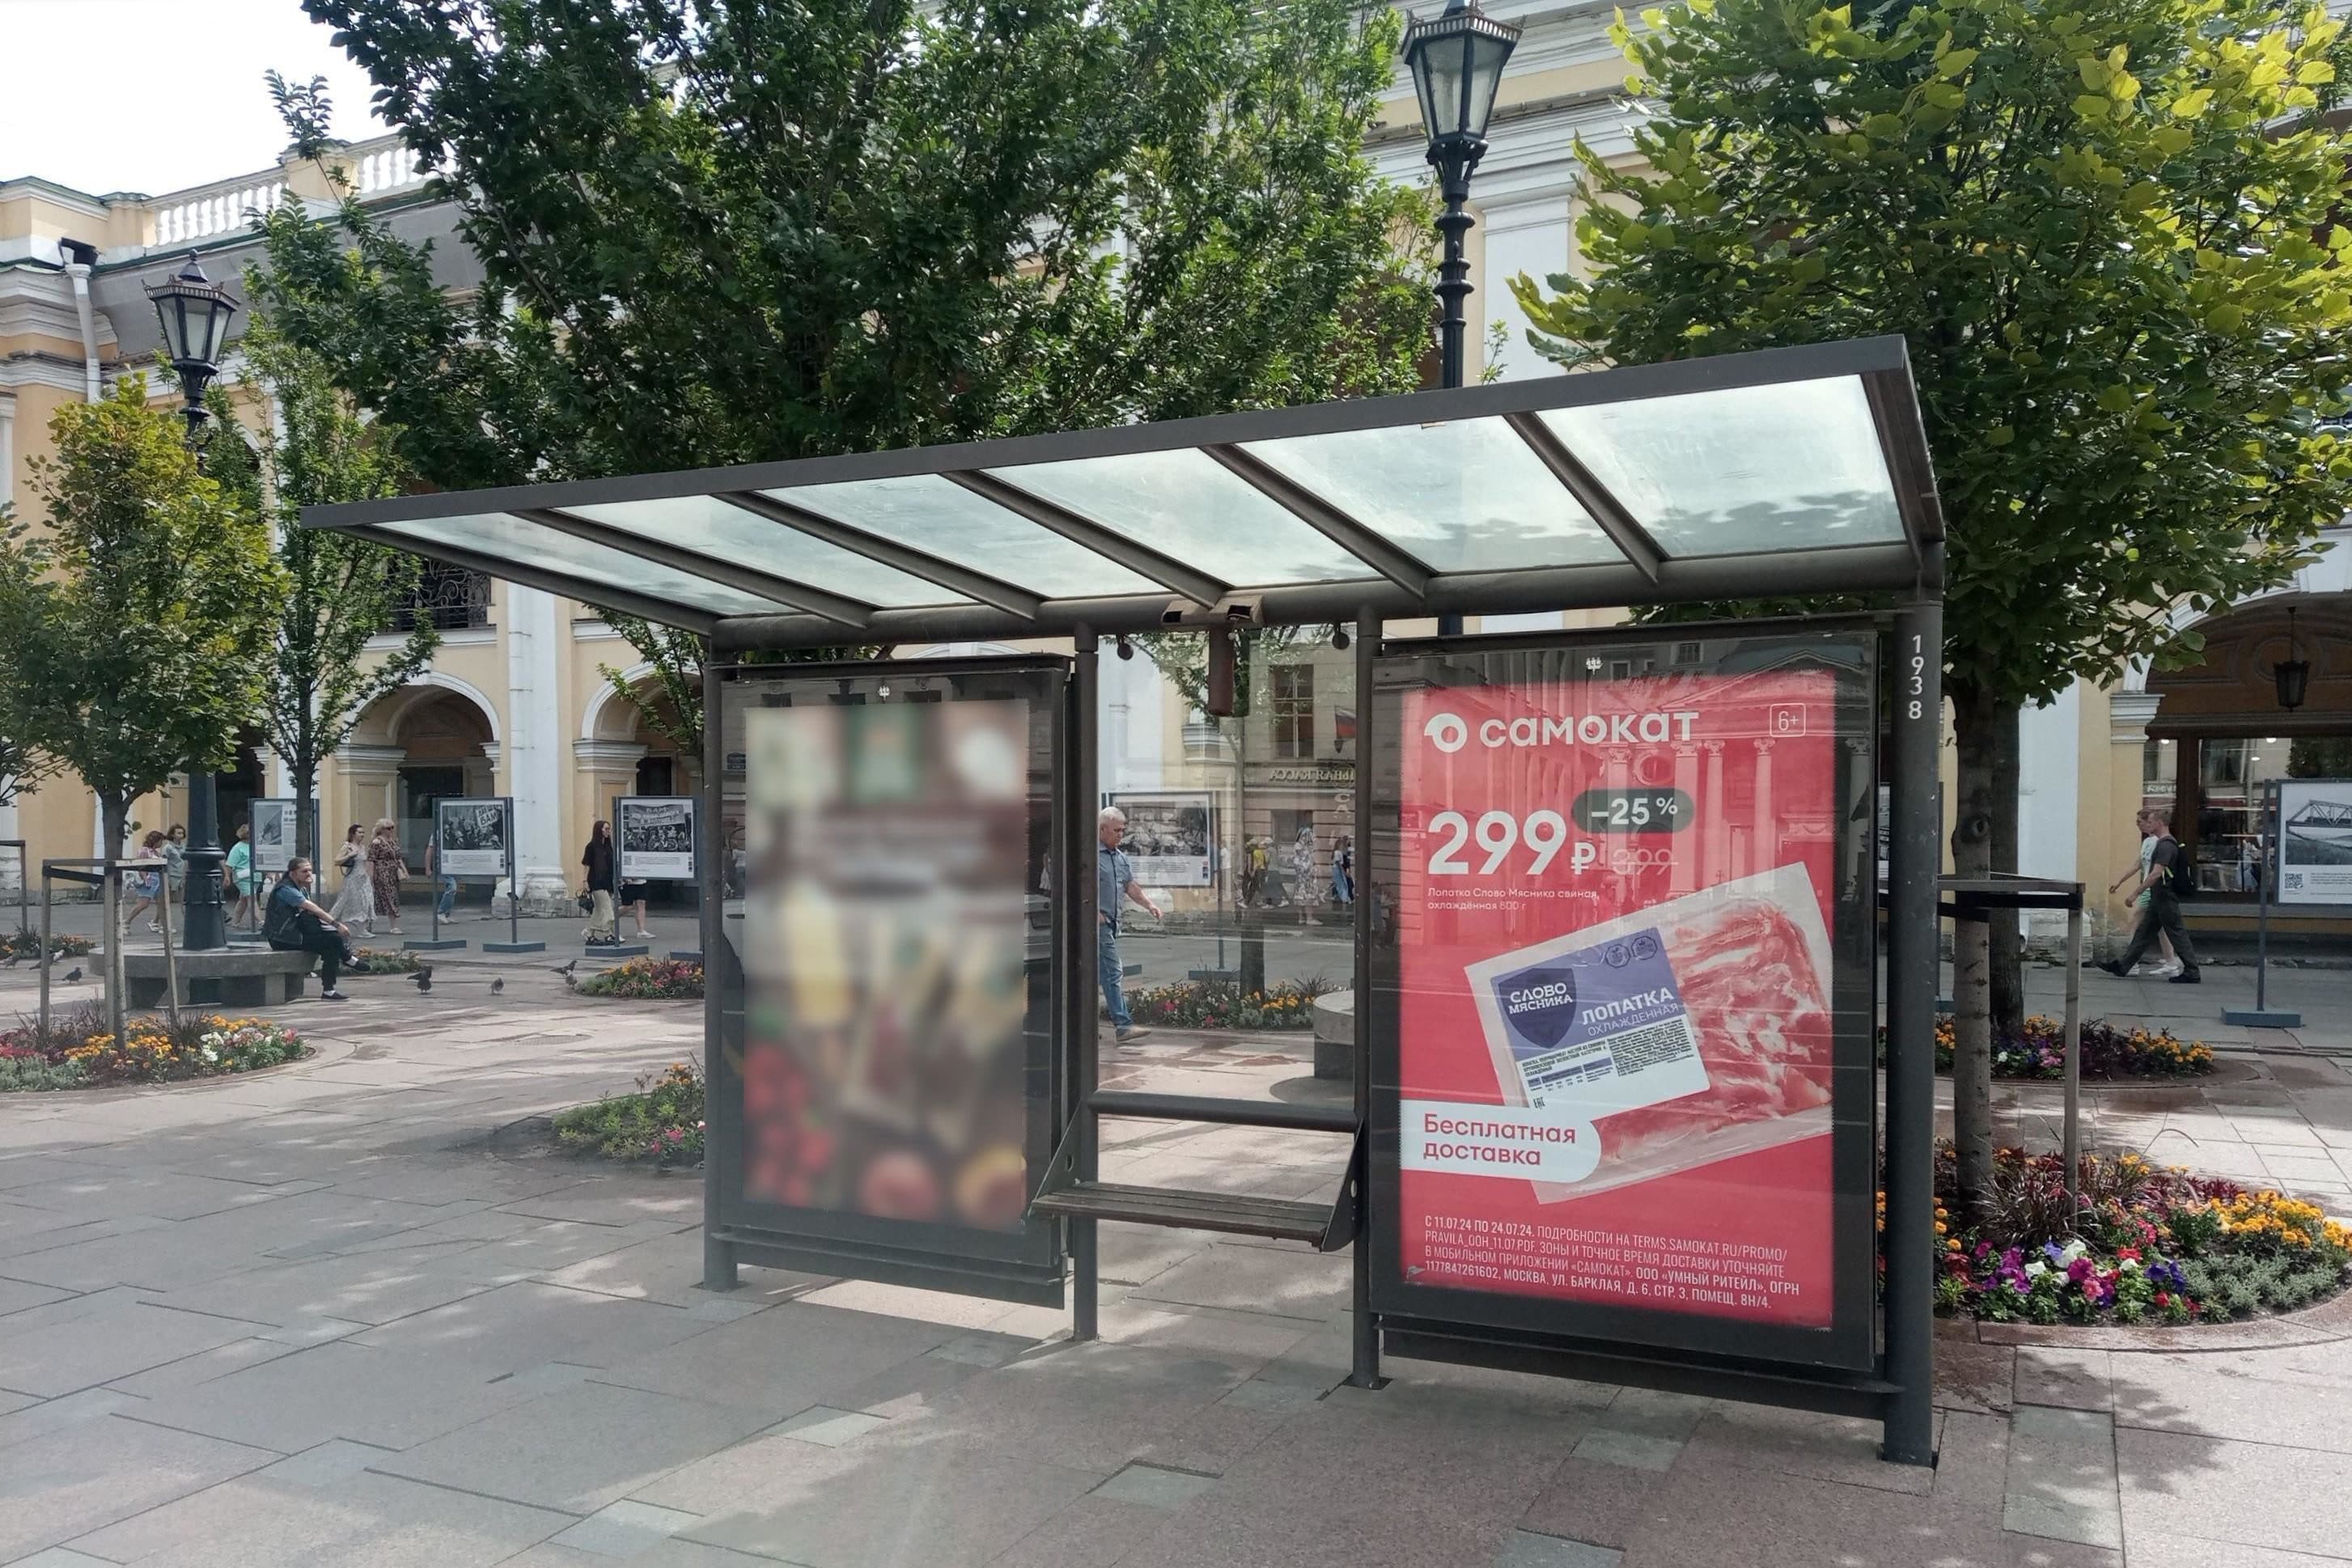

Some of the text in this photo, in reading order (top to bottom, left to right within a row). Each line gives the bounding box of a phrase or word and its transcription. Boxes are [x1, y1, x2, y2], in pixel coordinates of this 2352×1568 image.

[1909, 634, 1924, 719] 1938
[1778, 710, 1799, 731] 6+
[1428, 888, 1600, 900] Лопатка Слово Мясника свиная,
[1509, 994, 1573, 1015] МЯСНИКА
[1511, 982, 1567, 1004] СЛОВО
[1582, 987, 1674, 1025] ЛОПАТКА
[1588, 1003, 1679, 1036] ОХЛАЖДЕННАЯ
[1425, 1113, 1575, 1144] Бесплатная
[1423, 1142, 1540, 1166] доставка
[1426, 1215, 1788, 1261] С 11.07.24 ПО 24.07.24. ПОДРОБНОСТИ НА TERMS.SAMOKAT.RU/PROMO/
[1426, 1245, 1432, 1257] В
[1434, 1246, 1497, 1265] МОБИЛЬНОМ
[1499, 1252, 1569, 1271] ПРИЛОЖЕНИИ
[1636, 1267, 1659, 1280] ООО
[1662, 1270, 1710, 1286] «УМНЫЙ
[1769, 1281, 1799, 1295] ОГРН
[1540, 1241, 1569, 1255] ЗОНЫ
[1572, 1244, 1579, 1257] И
[1582, 1245, 1621, 1261] ТОЧНОЕ
[1625, 1250, 1659, 1265] ВРЕМЯ
[1663, 1253, 1719, 1270] ДОСТАВКИ
[1722, 1259, 1785, 1278] УТОЧНЯЙТЕ
[1504, 1269, 1549, 1285] МОСКВА,
[1552, 1273, 1568, 1286] УЛ.
[1571, 1275, 1624, 1294] БАРКЛАЯ,
[1627, 1283, 1638, 1295] Д.
[1642, 1283, 1651, 1297] 6,
[1655, 1285, 1676, 1299] СТР.
[1692, 1288, 1738, 1307] ПОМЕЩ.
